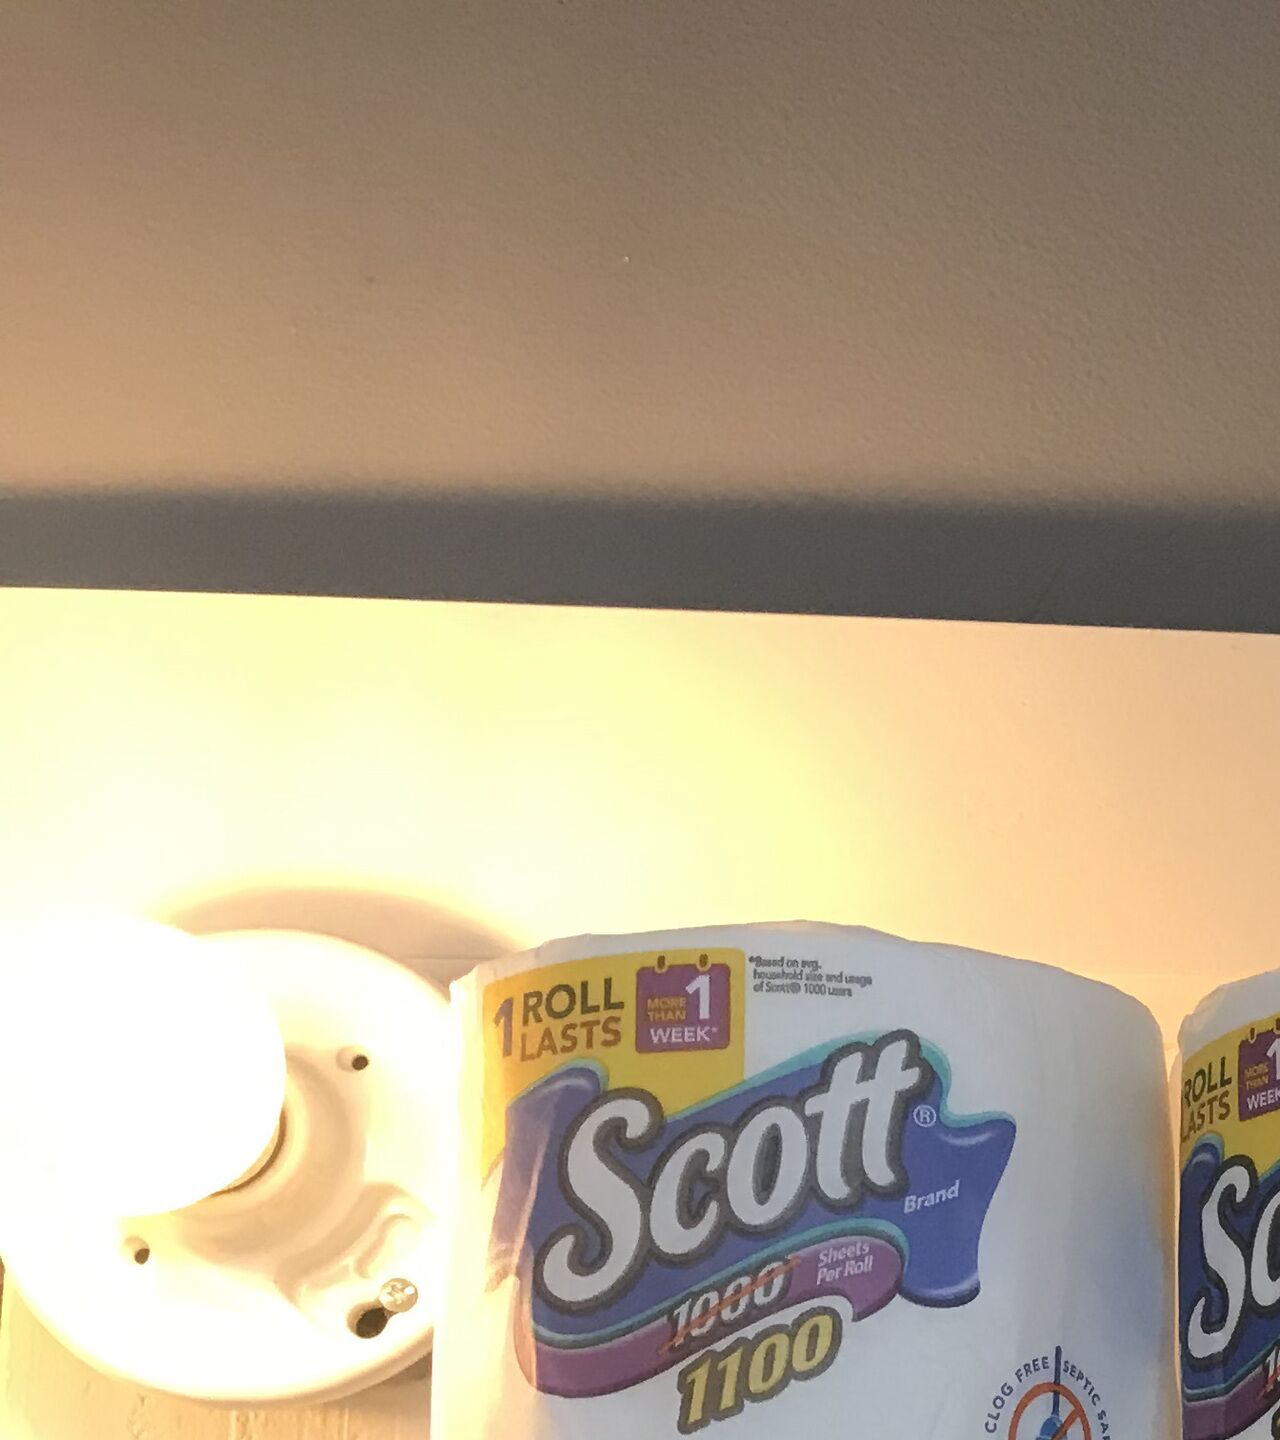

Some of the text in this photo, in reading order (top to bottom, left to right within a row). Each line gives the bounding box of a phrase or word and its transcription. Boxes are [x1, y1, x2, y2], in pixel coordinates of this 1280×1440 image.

[647, 996, 687, 1011] MORE
[686, 974, 712, 1020] 1
[804, 983, 826, 995] 1000
[494, 977, 625, 1058] 1 ROLL
[647, 1009, 687, 1022] THAN
[520, 1016, 622, 1062] LASTS
[537, 1031, 927, 1310] Scott
[903, 1180, 960, 1213] Brand
[816, 1254, 874, 1286] Per Roll
[817, 1242, 870, 1268] Sheets
[672, 1260, 790, 1348] 1000
[680, 1308, 840, 1432] 1100
[984, 1382, 1015, 1434] CLOG
[1014, 1356, 1050, 1384] FREE
[1062, 1360, 1102, 1407] SEPTIC
